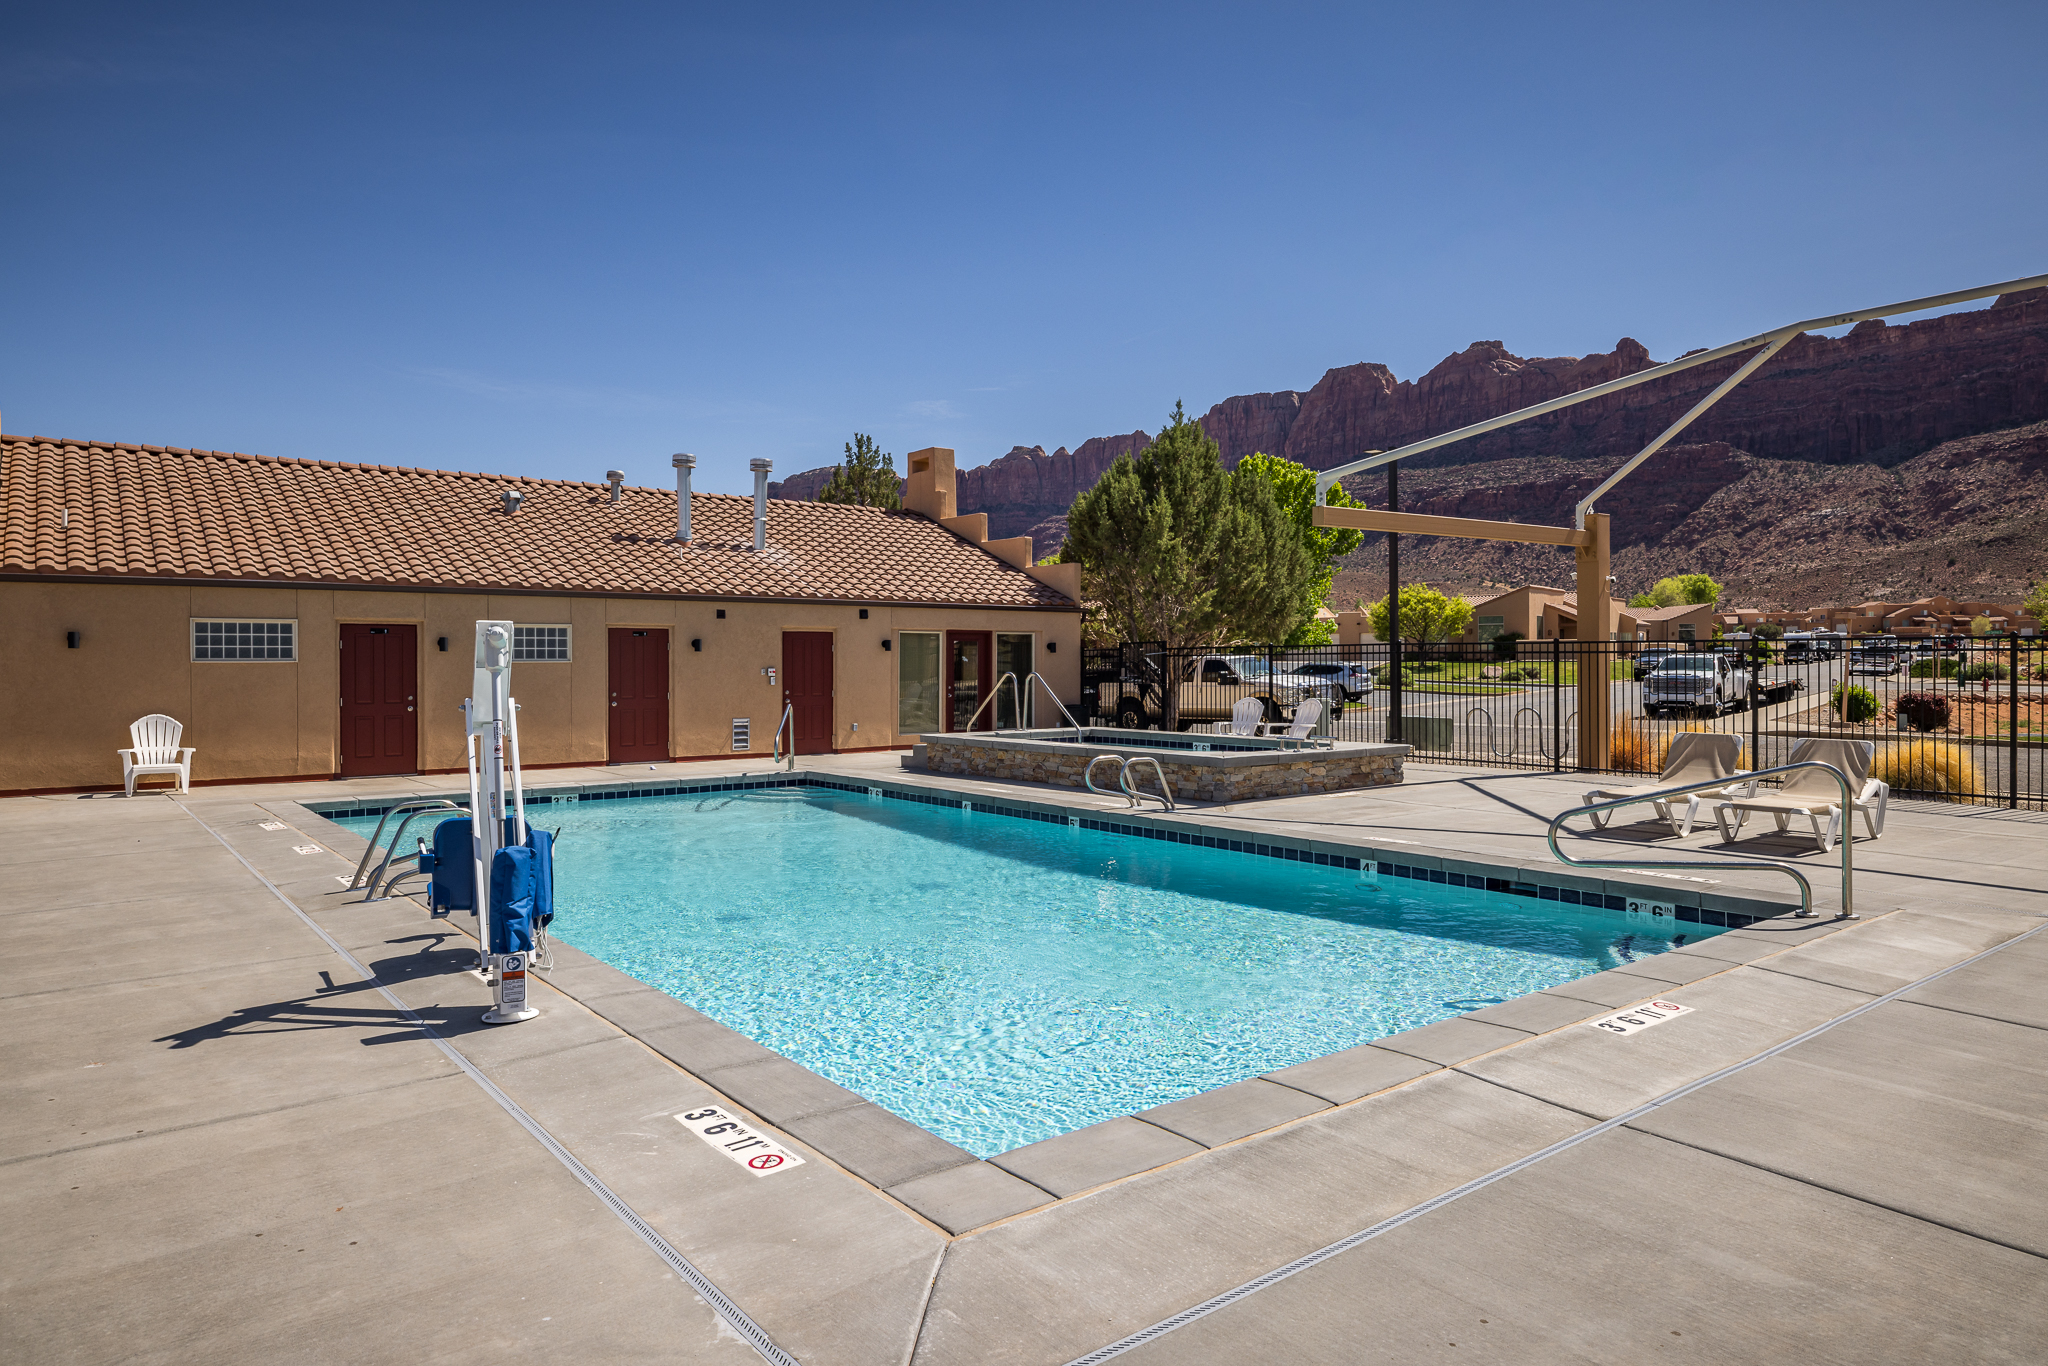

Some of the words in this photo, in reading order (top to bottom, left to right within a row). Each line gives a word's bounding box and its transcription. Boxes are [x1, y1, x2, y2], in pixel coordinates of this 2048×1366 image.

[1652, 905, 1663, 917] 6
[1664, 906, 1672, 914] IN
[1598, 1022, 1627, 1033] 3
[1616, 1016, 1646, 1025] 6
[684, 1109, 718, 1121] 3
[703, 1122, 739, 1135] 6
